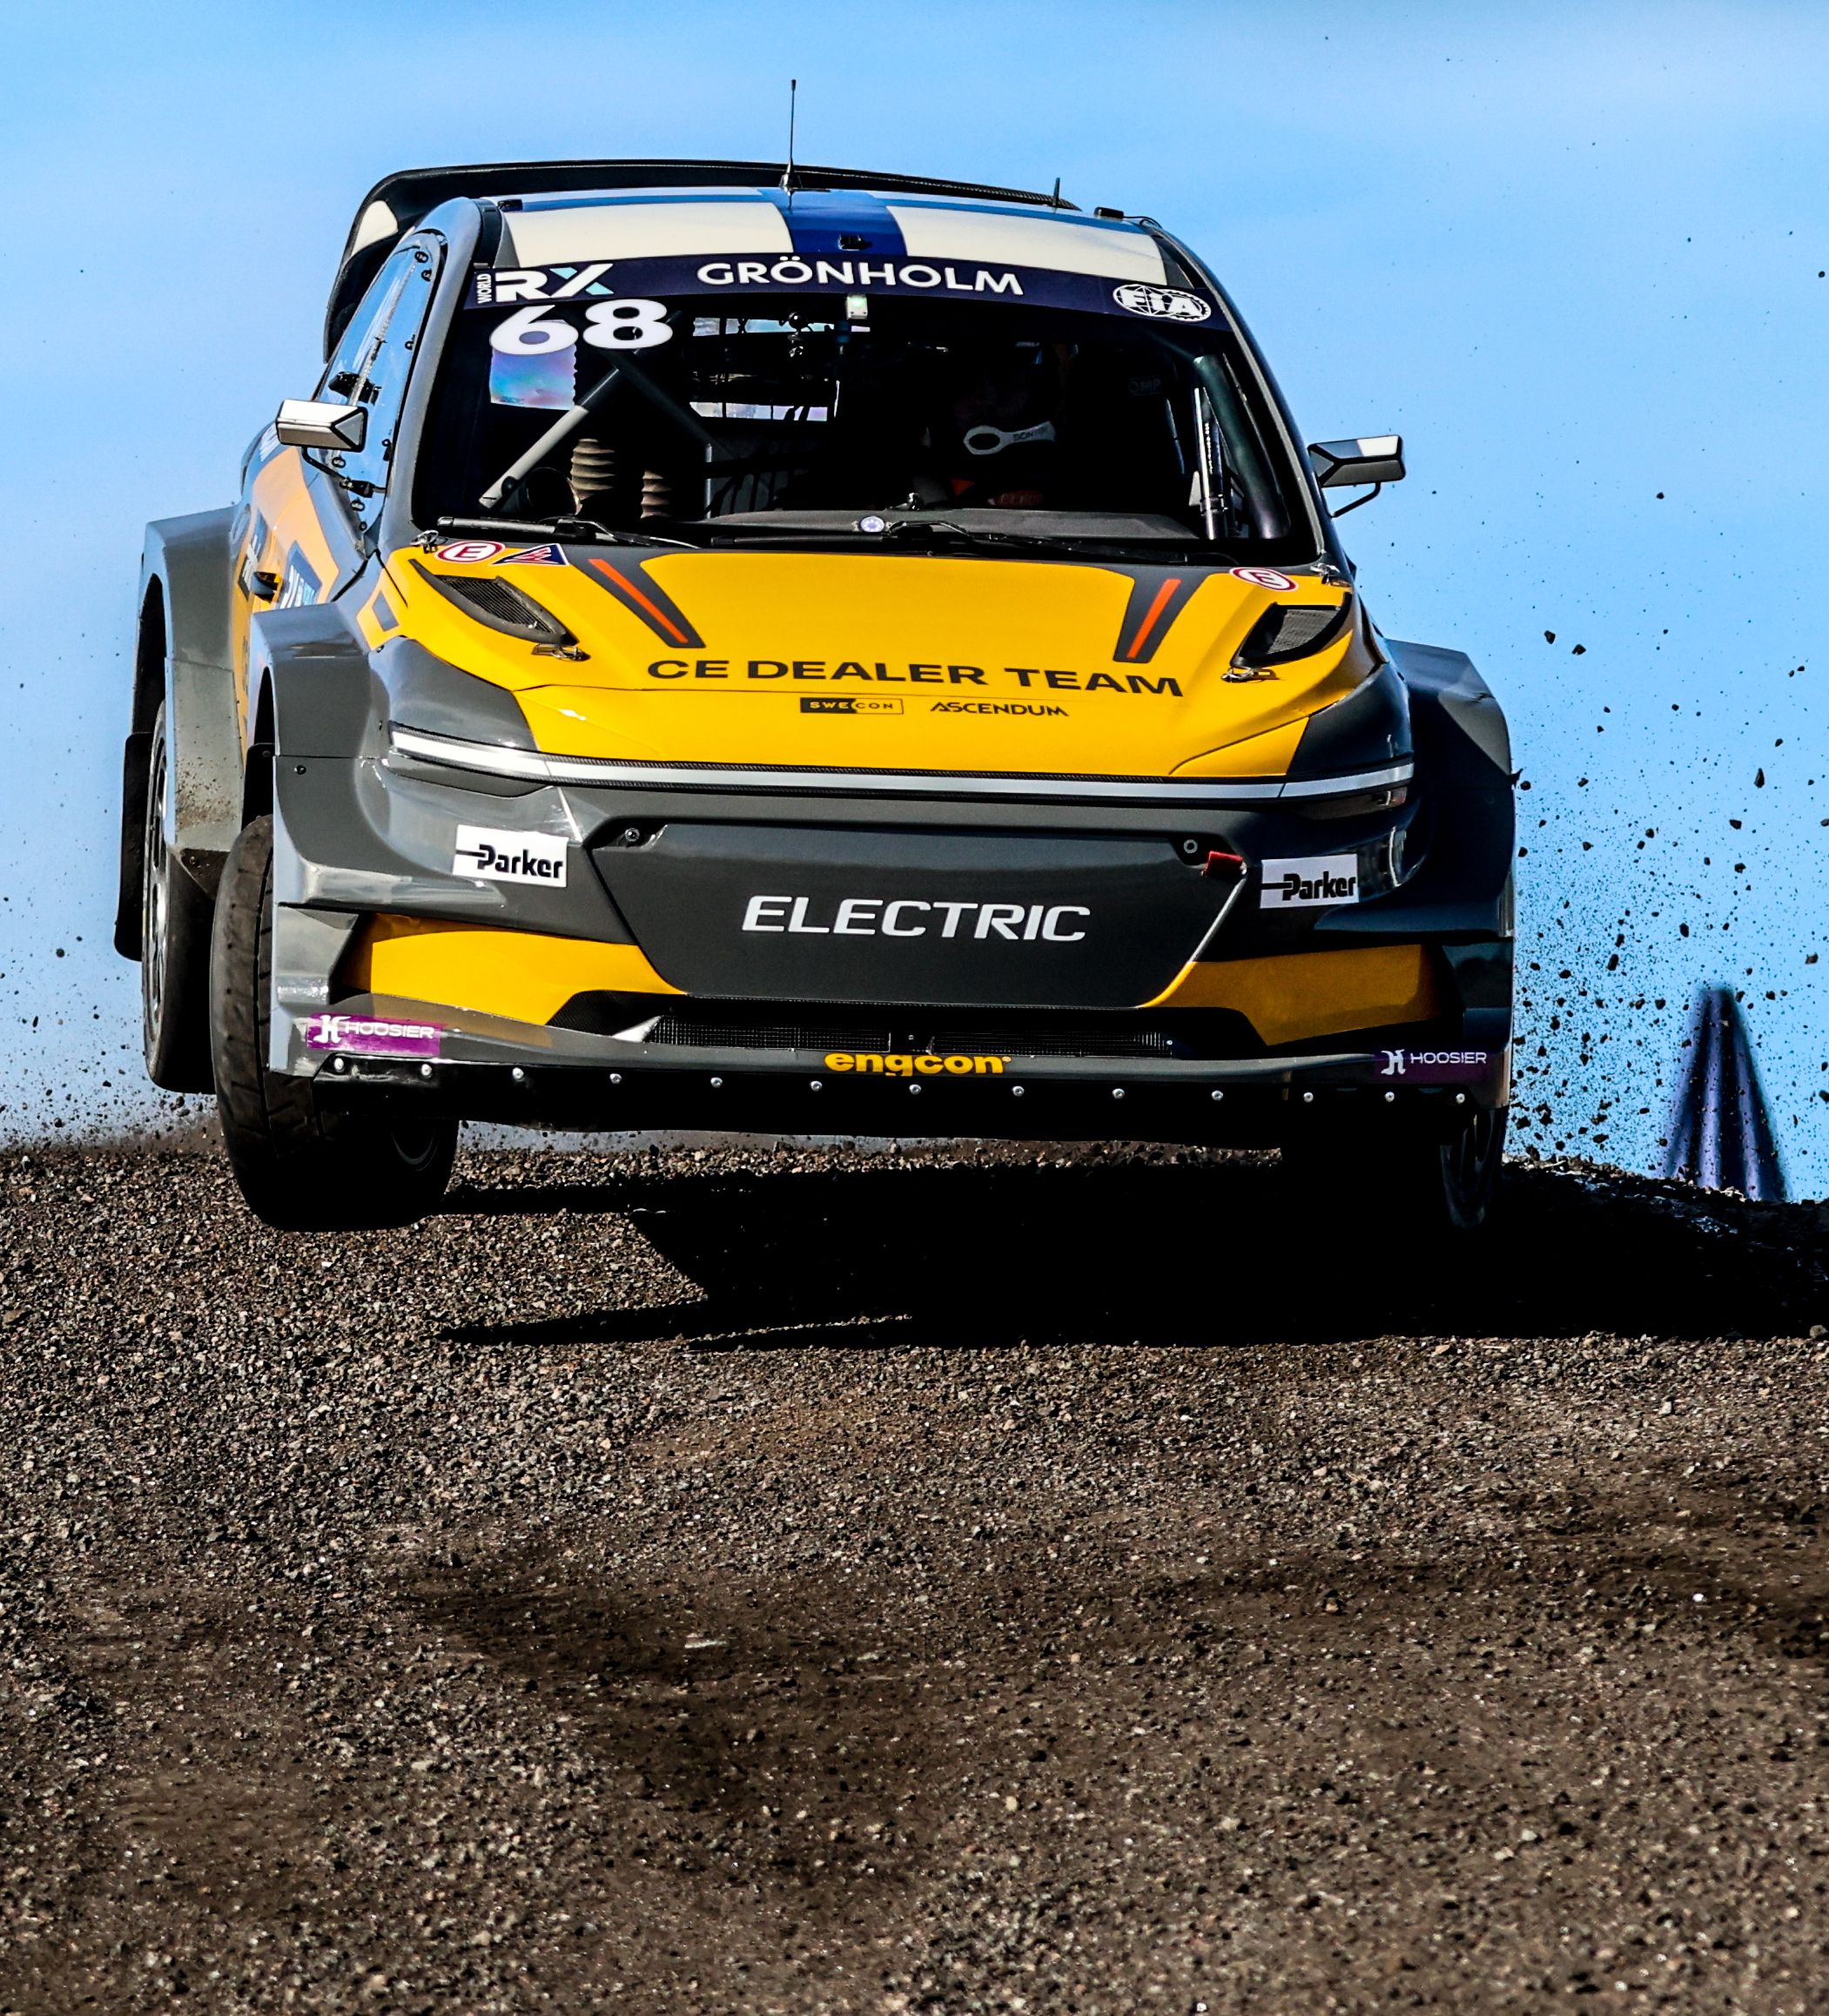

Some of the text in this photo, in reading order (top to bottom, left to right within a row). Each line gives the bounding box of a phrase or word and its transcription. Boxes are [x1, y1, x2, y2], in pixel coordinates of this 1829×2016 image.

[476, 272, 492, 305] WORLD
[494, 263, 615, 303] RX
[697, 255, 1025, 296] GRÖNHOLM
[1118, 287, 1204, 316] FIA
[488, 298, 674, 355] 68
[454, 544, 488, 559] E
[1247, 571, 1283, 587] E
[647, 659, 1184, 697] CE DEALER TEAM
[808, 701, 894, 710] SWECON
[929, 701, 1070, 717] ASCENDUM
[474, 843, 564, 879] Parker
[1280, 872, 1357, 901] Parker
[741, 895, 1092, 942] ELECTRIC
[346, 1019, 435, 1040] HOOSIER
[824, 1052, 1005, 1078] engcon
[1409, 1052, 1488, 1065] HOOSIER
